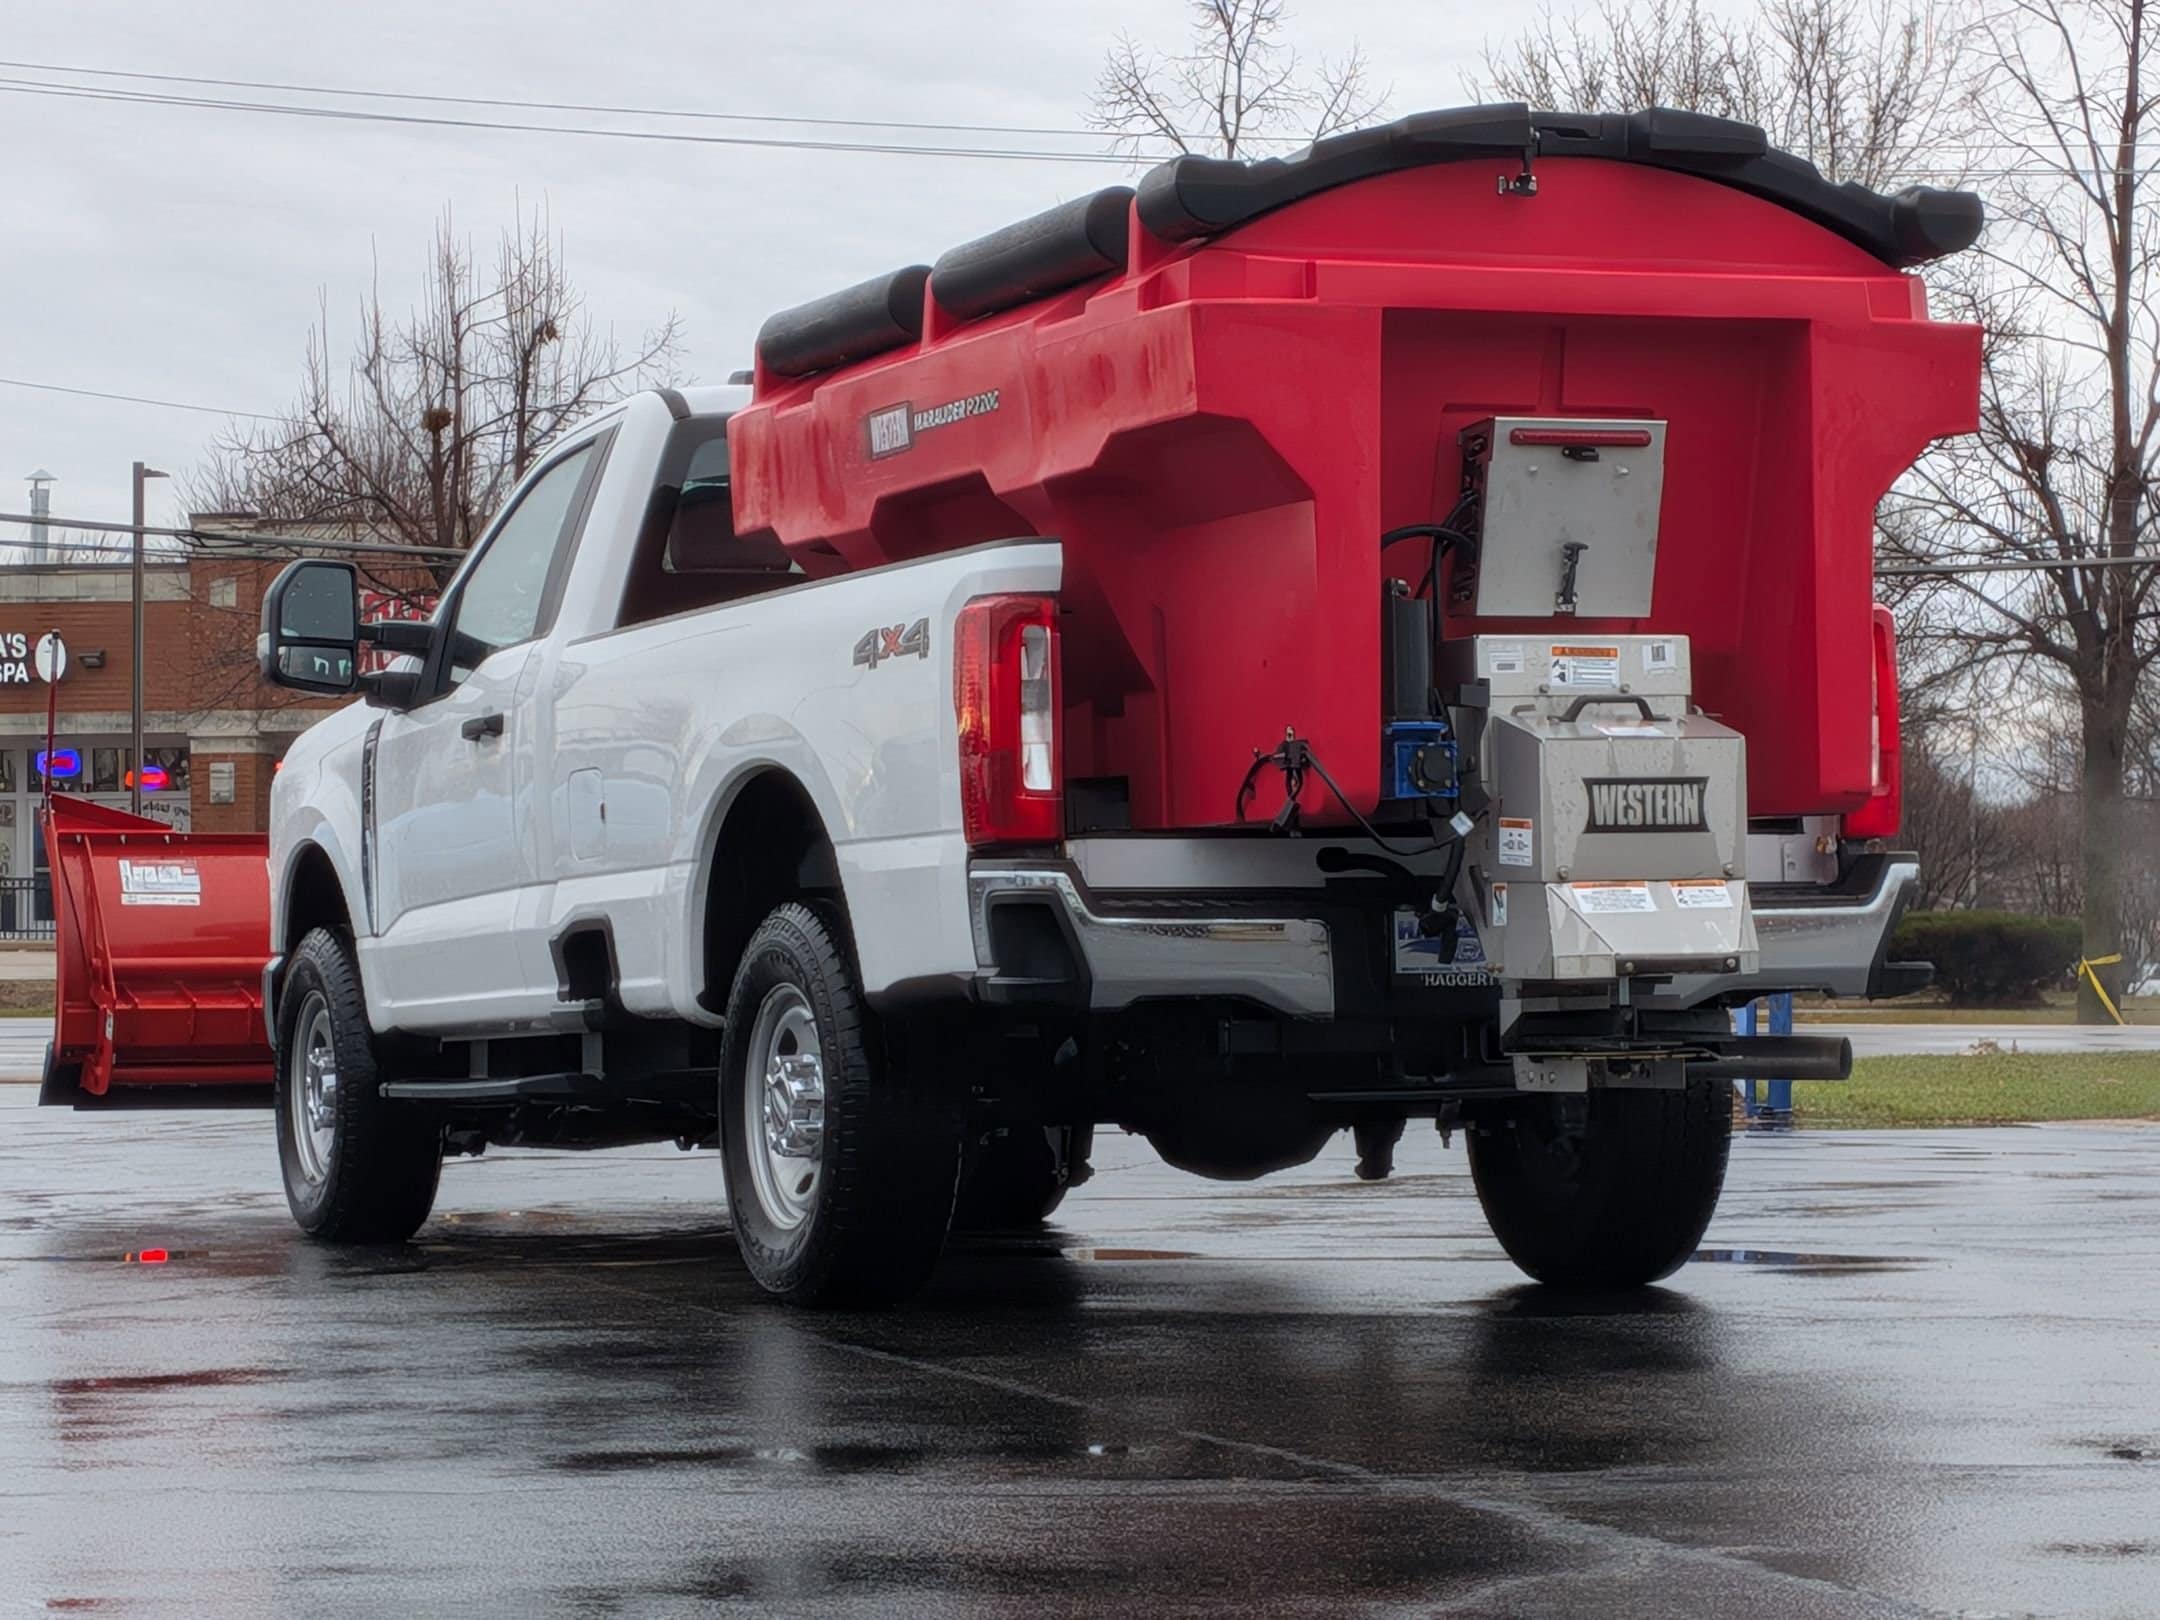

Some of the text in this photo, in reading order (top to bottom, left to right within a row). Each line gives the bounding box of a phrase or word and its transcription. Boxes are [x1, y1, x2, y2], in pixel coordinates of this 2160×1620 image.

[914, 400, 965, 431] MARAUDER
[0, 662, 29, 683] PA
[1592, 784, 1700, 825] WESTERN
[1424, 973, 1498, 987] HAGGERT
